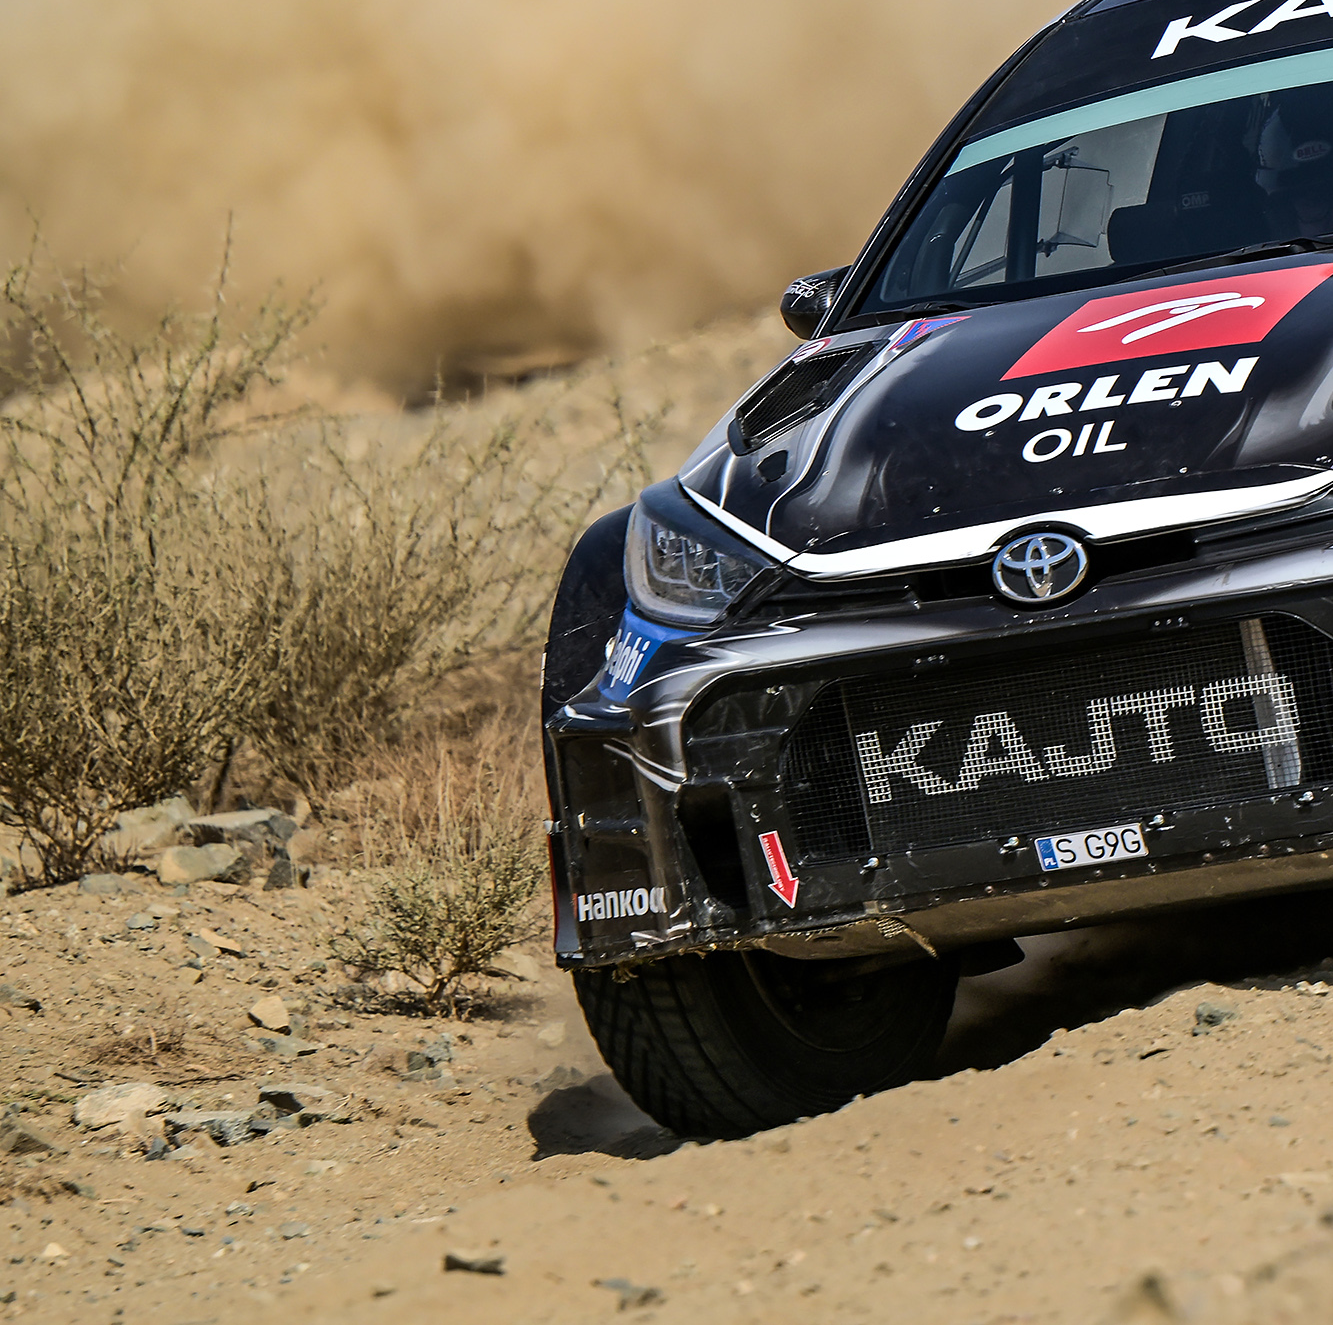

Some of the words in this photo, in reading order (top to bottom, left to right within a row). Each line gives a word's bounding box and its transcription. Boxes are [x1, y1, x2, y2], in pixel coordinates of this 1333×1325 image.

[954, 356, 1260, 432] ORLEN
[1022, 420, 1128, 464] OIL
[855, 672, 1301, 804] KAJTO
[1056, 838, 1076, 864] S
[1084, 829, 1141, 860] G9G
